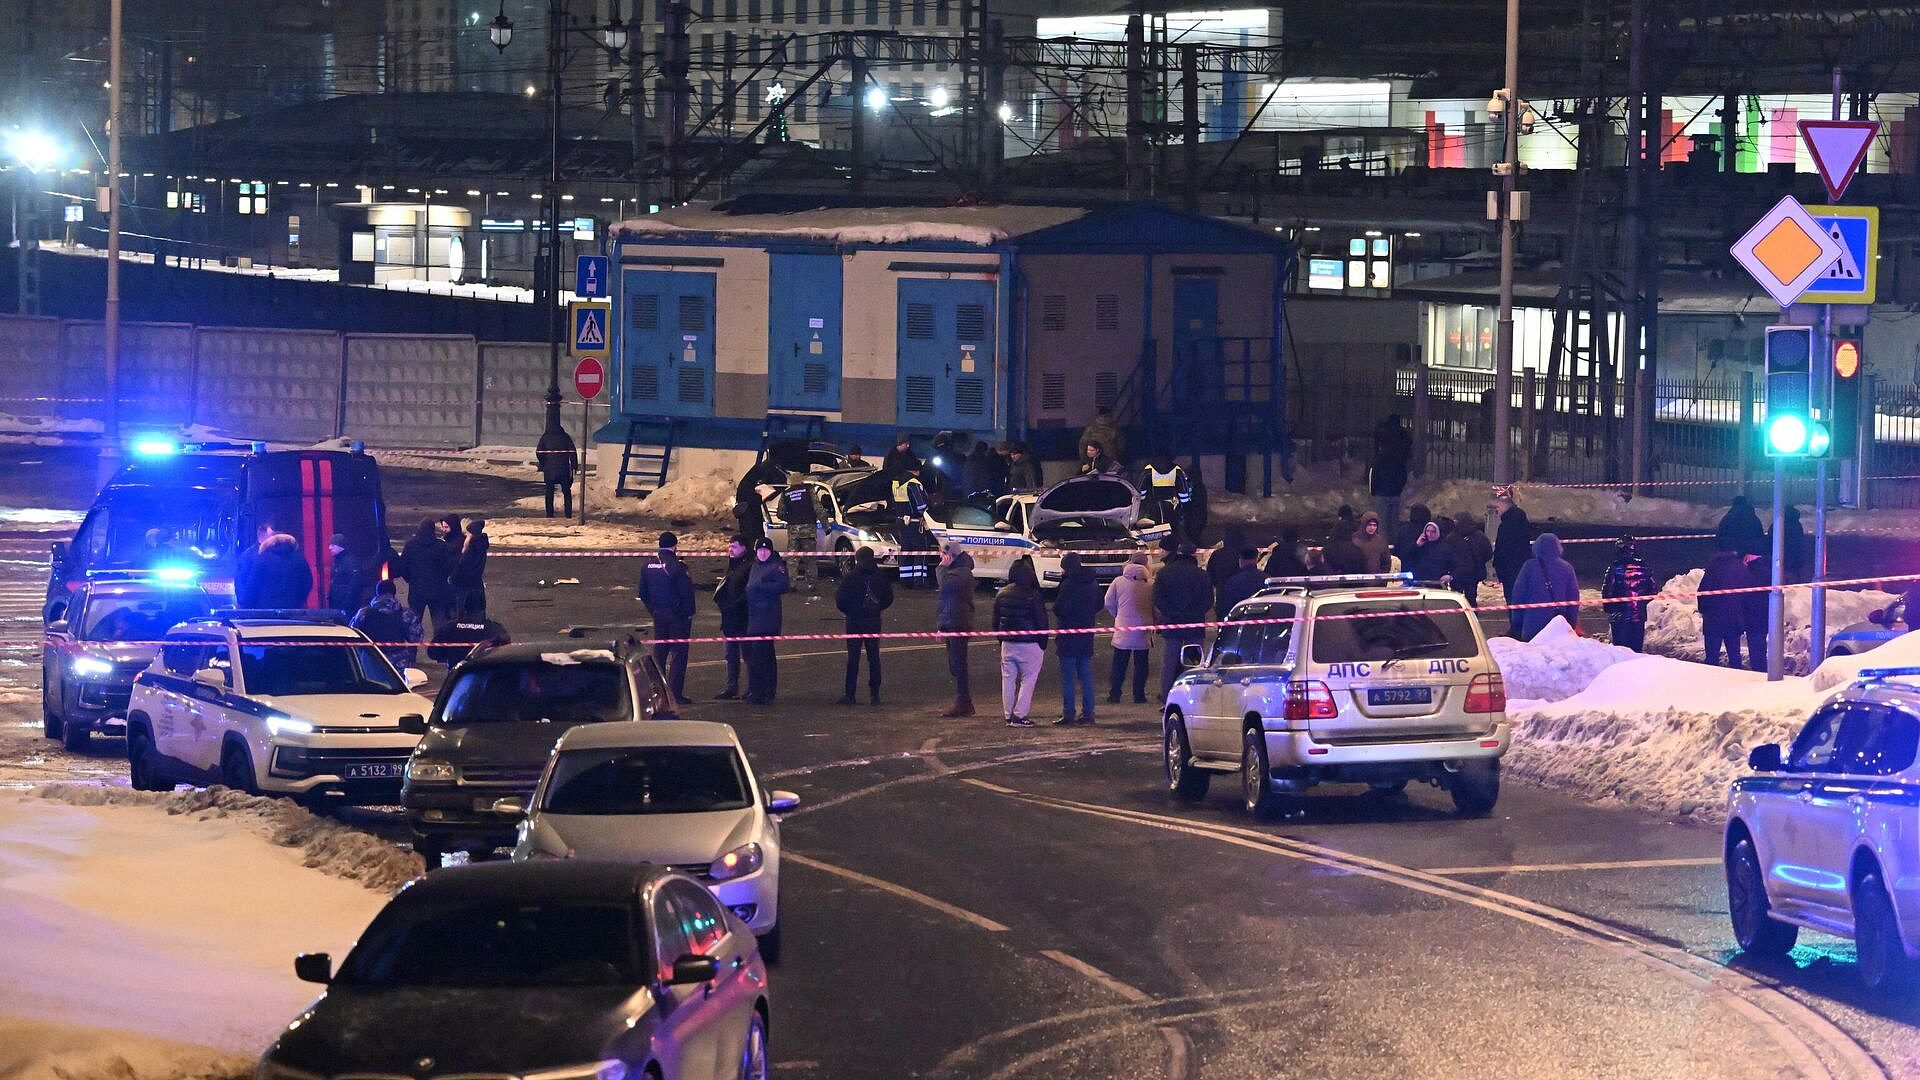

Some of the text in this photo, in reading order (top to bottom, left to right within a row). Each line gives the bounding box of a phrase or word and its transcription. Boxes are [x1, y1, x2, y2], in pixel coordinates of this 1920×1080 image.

[967, 537, 1005, 545] ПОЛИЦИЯ
[1328, 663, 1371, 678] ДПС
[1429, 659, 1470, 674] ДПС
[1384, 690, 1411, 702] 5792
[350, 764, 402, 776] А 5132 99
